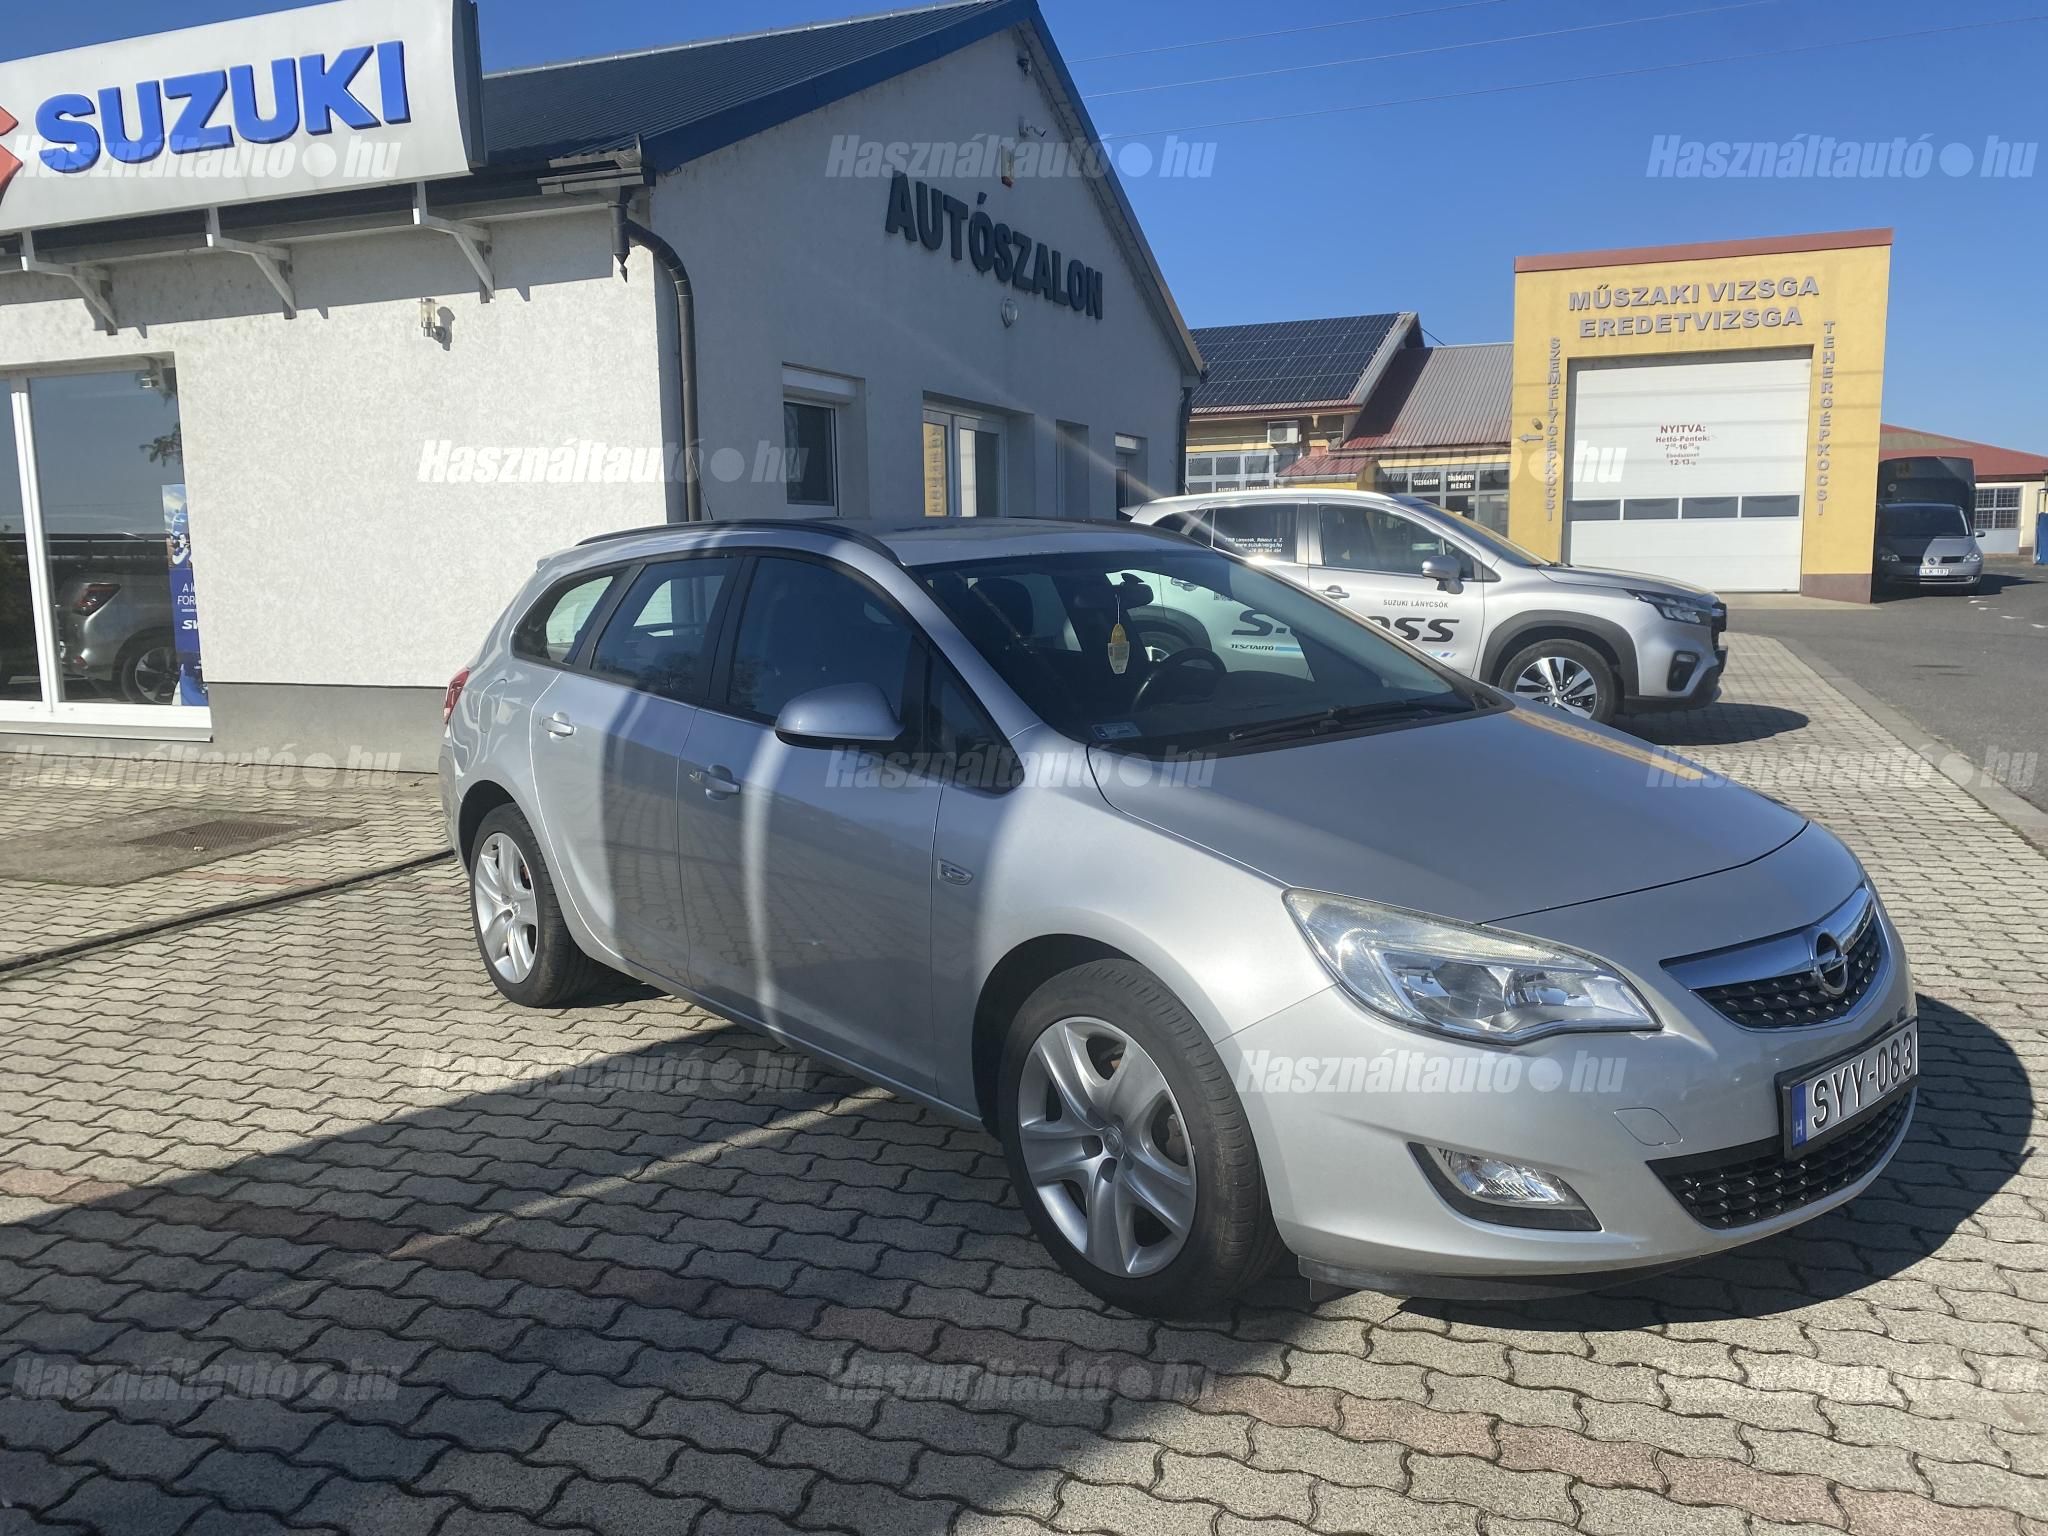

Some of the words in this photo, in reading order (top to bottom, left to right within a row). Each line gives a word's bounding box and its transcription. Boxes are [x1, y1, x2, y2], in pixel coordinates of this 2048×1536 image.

[35, 41, 411, 173] SUZUKI
[885, 171, 1103, 320] AUTÓSZALON
[1568, 284, 1700, 311] MŰSZAKI
[1707, 276, 1820, 303] VIZSGA
[1579, 306, 1803, 338] EREDETVIZSGA
[1660, 424, 1706, 434] NYITVA:
[1383, 599, 1408, 607] SUZUKI
[1812, 1031, 1912, 1129] SYY-083
